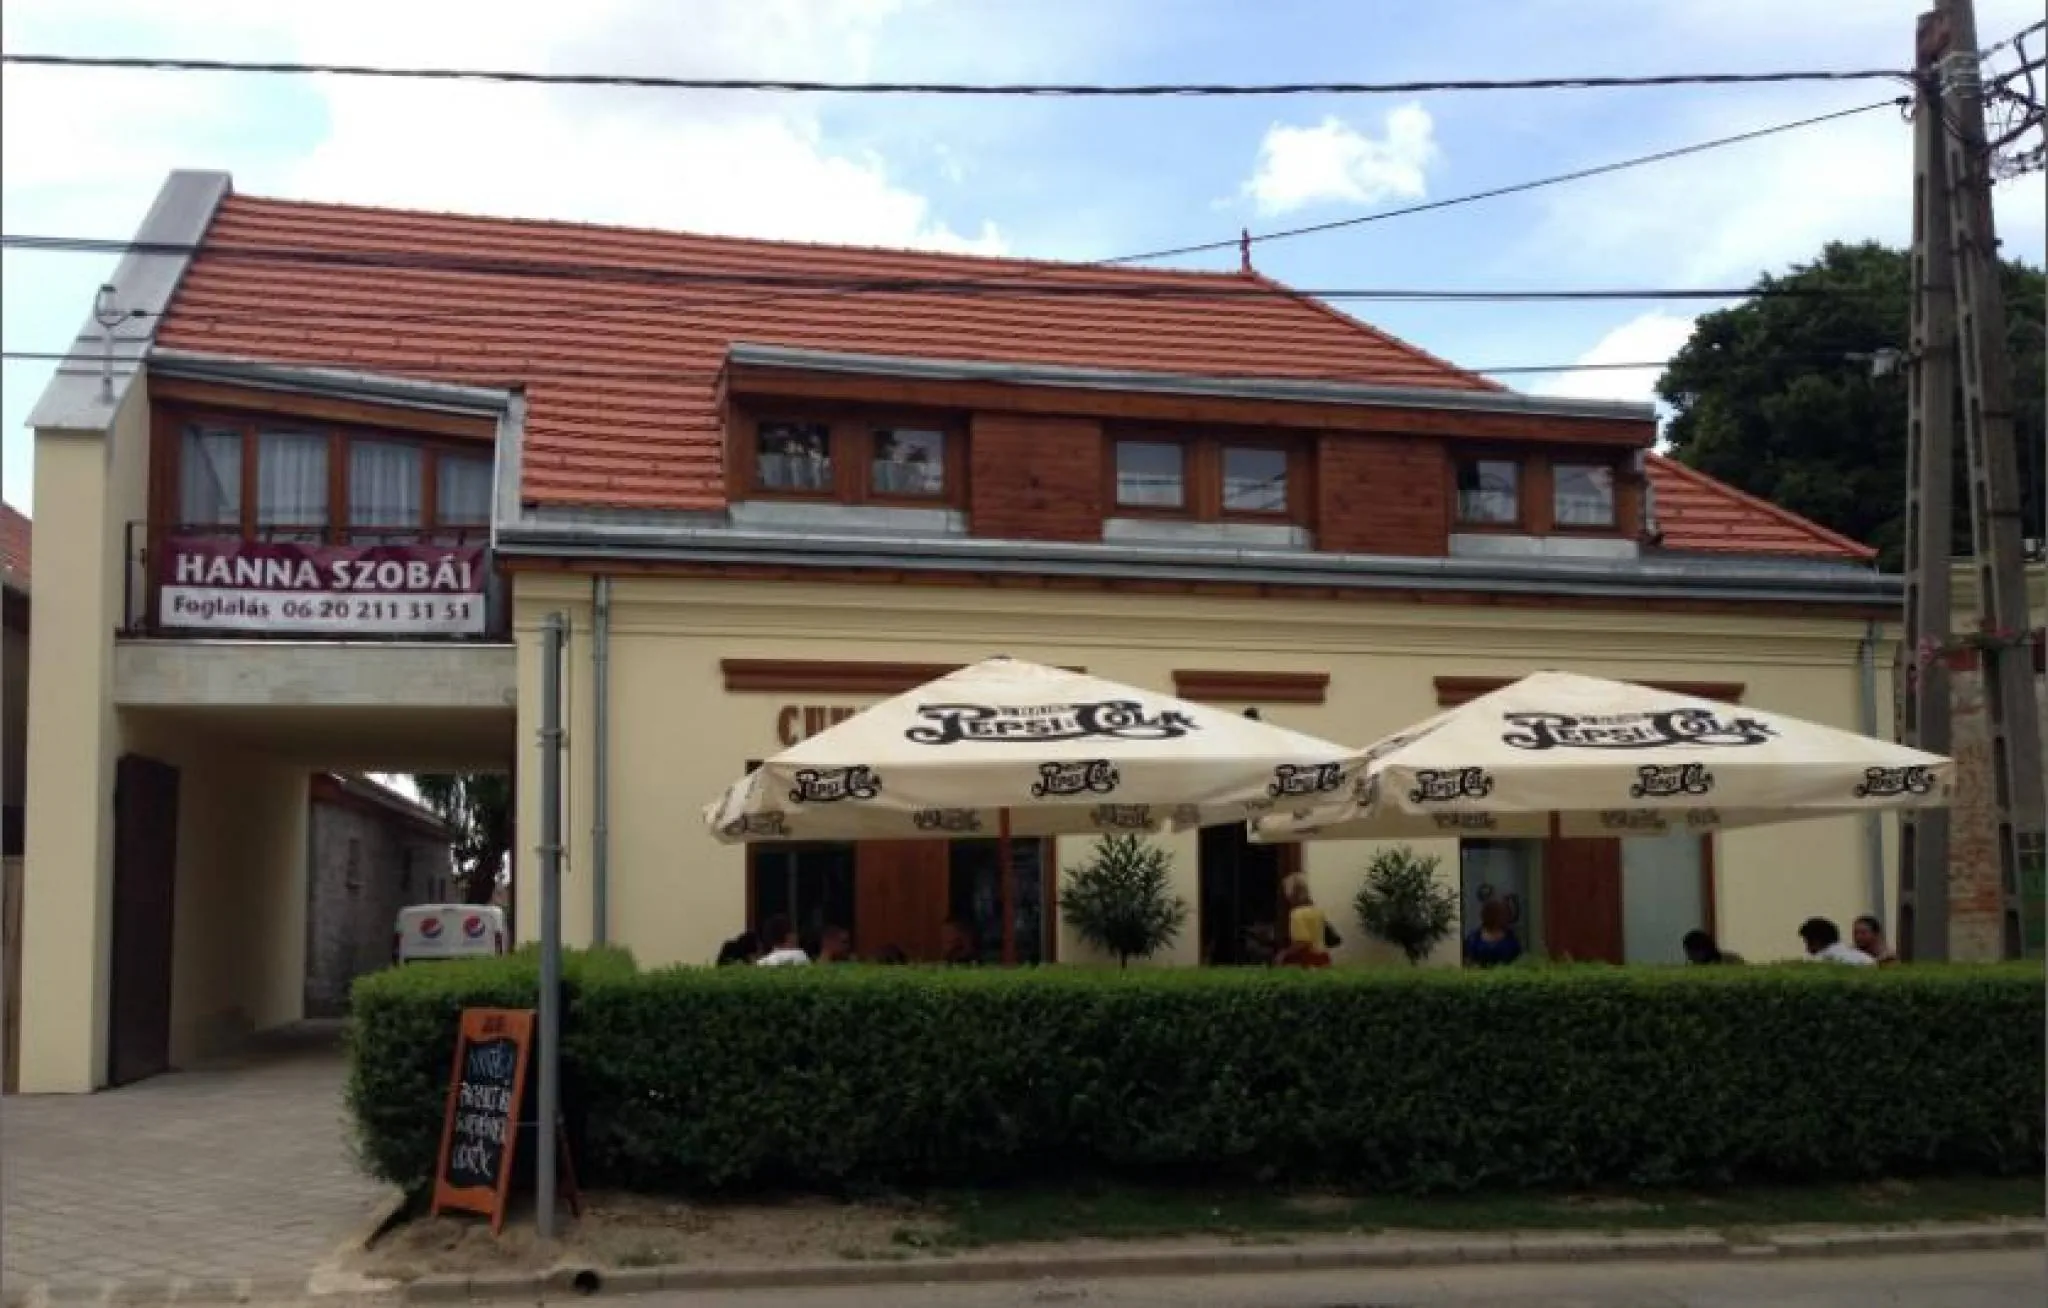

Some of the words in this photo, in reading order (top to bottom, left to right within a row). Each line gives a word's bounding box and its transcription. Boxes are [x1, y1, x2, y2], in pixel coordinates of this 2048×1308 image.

[176, 553, 322, 588] HANNA
[332, 553, 472, 589] SZOBÁI
[283, 600, 312, 618] 06
[319, 601, 349, 618] 20
[357, 602, 399, 620] 211
[409, 602, 434, 620] 31
[445, 602, 471, 620] 51
